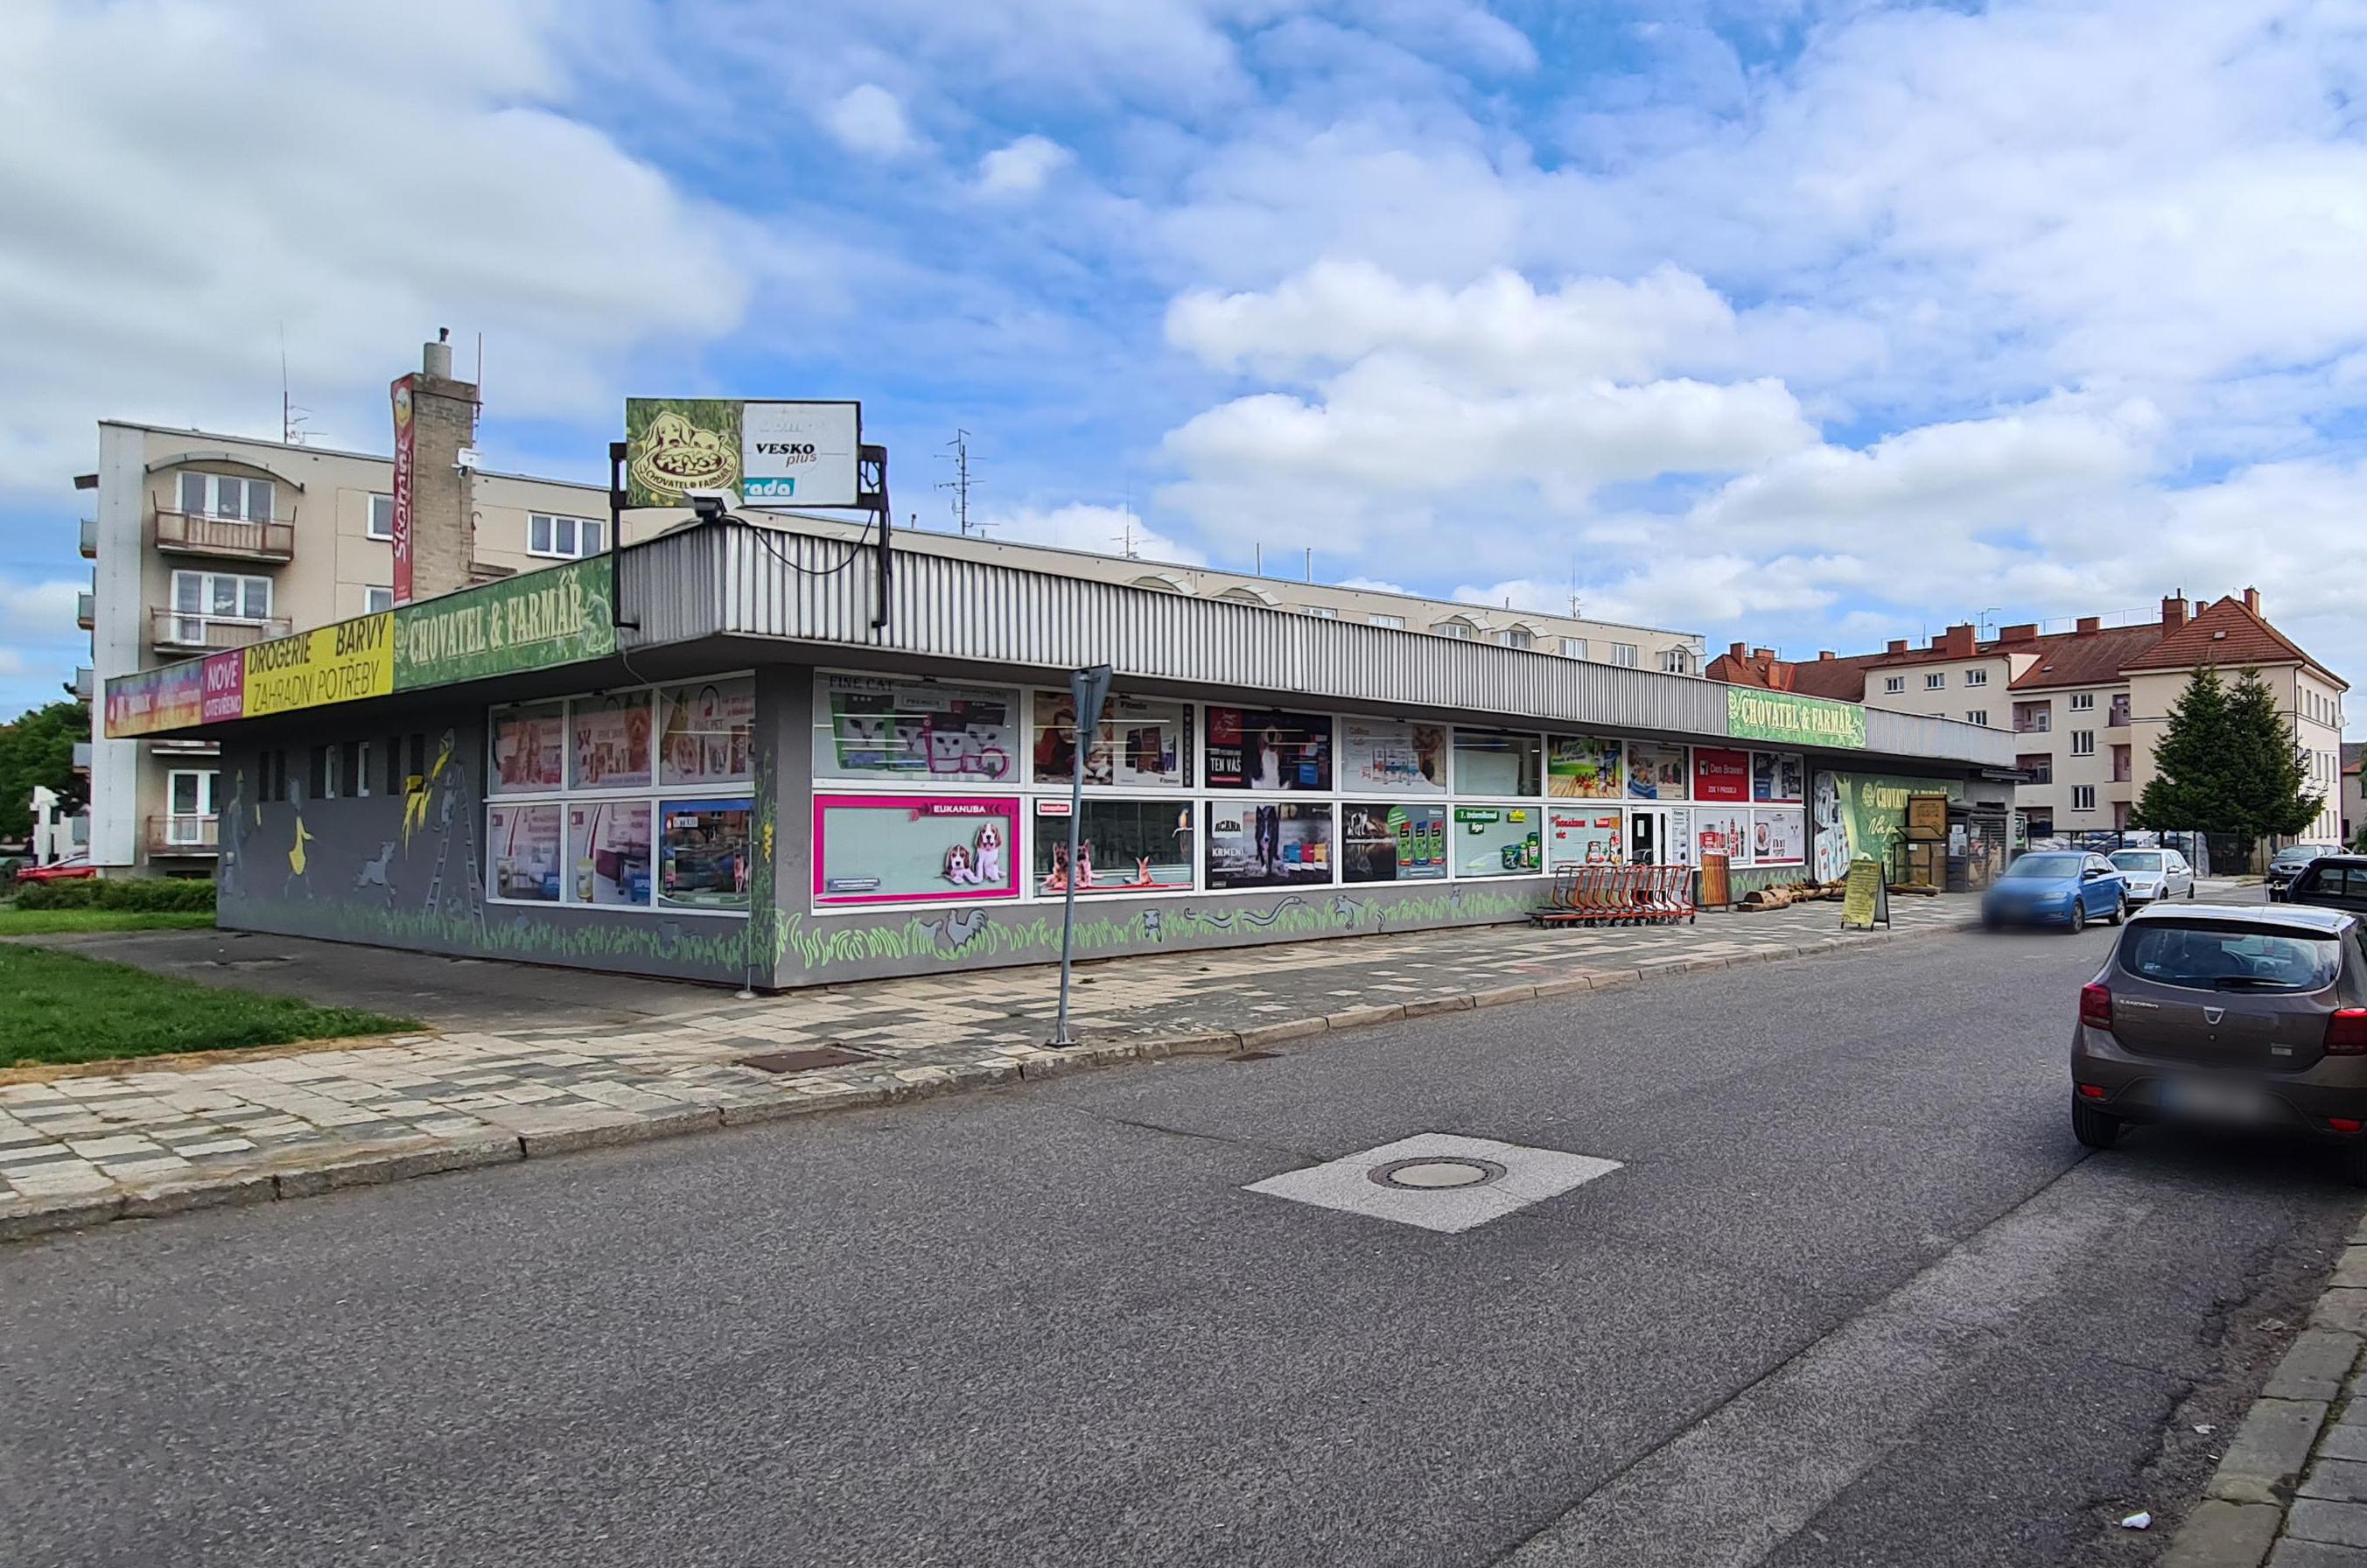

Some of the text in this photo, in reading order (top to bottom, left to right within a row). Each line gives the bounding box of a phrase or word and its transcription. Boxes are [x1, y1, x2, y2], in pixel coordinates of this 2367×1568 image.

[755, 443, 816, 455] VESKO
[785, 452, 817, 468] plus
[646, 469, 690, 489] CHOVATEL
[409, 568, 584, 664] CHOVATEL & FARMÁŘ
[249, 615, 388, 675] DROGERIE BARVY
[252, 663, 317, 712] ZAHRADNÍ
[317, 658, 381, 700] POTŘEBY
[829, 676, 894, 691] FINE CAT
[1741, 697, 1801, 730] CHOVATEL
[1801, 705, 1810, 732] &
[1210, 755, 1242, 773] TEN VÁŠ
[933, 804, 986, 814] EUKANUBA
[1215, 820, 1242, 832] ACANA
